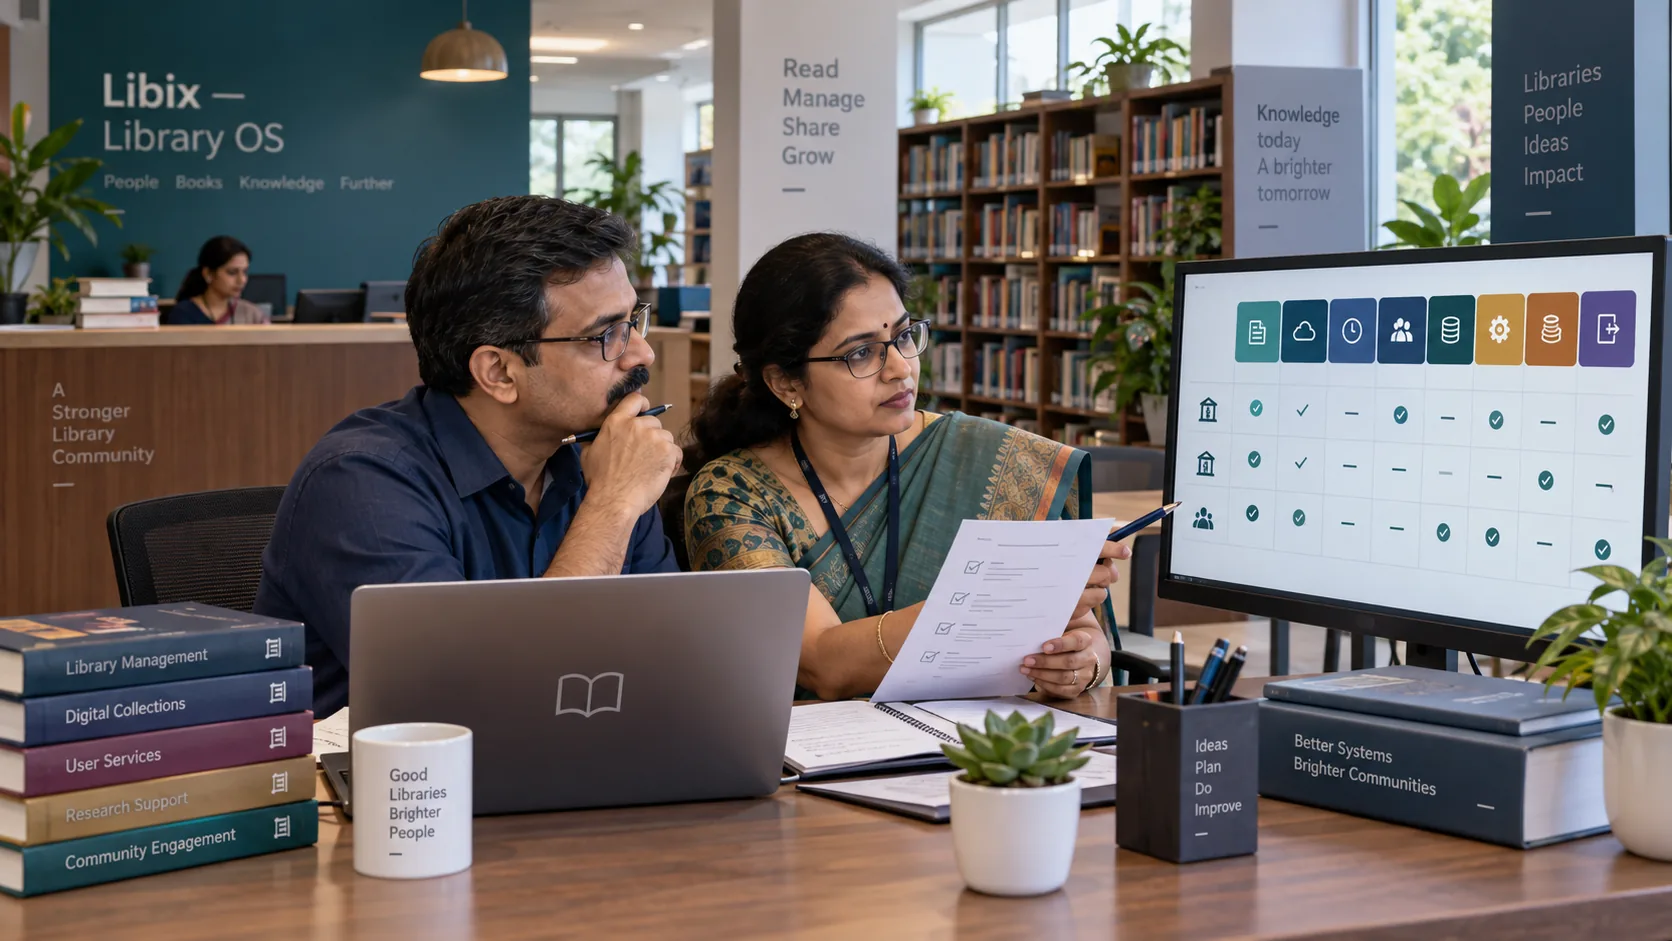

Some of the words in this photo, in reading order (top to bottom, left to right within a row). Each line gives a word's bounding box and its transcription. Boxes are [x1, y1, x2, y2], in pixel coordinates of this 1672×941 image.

[784, 58, 838, 78] Read
[1525, 64, 1601, 92] Libraries
[104, 72, 200, 108] Libix
[784, 88, 865, 112] Manage
[1258, 104, 1339, 127] Knowledge
[1525, 98, 1582, 124] People
[783, 117, 840, 136] Share
[105, 120, 224, 160] Library
[236, 123, 284, 152] OS
[1257, 131, 1300, 152] today
[1525, 134, 1568, 155] Ideas
[782, 146, 834, 165] Grow
[1257, 158, 1269, 174] A
[1274, 157, 1332, 179] brighter
[1525, 163, 1583, 188] Impact
[105, 175, 159, 190] People
[176, 175, 223, 189] Books
[240, 176, 324, 193] Knowledge
[341, 176, 394, 190] Further
[1258, 186, 1330, 201] tomorrow
[52, 383, 65, 397] A
[53, 405, 130, 424] Stronger
[53, 426, 115, 443] Library
[53, 446, 154, 465] Community
[67, 659, 117, 676] Library
[122, 649, 208, 672] Management
[66, 705, 109, 725] Digital
[114, 699, 185, 717] Collections
[1196, 739, 1227, 752] Ideas
[1295, 734, 1334, 754] Better
[1338, 741, 1392, 765] Systems
[66, 758, 99, 773] User
[104, 750, 161, 767] Services
[1196, 760, 1221, 774] Plan
[390, 768, 427, 782] Good
[1295, 757, 1345, 780] Brighter
[1349, 767, 1436, 795] Communities
[390, 787, 446, 801] Libraries
[1196, 782, 1212, 795] Do
[66, 800, 130, 823] Research
[134, 792, 188, 812] Support
[390, 806, 440, 822] Brighter
[1196, 802, 1241, 817] Improve
[390, 825, 434, 841] People
[66, 845, 147, 871] Community
[152, 828, 236, 855] Engagement
